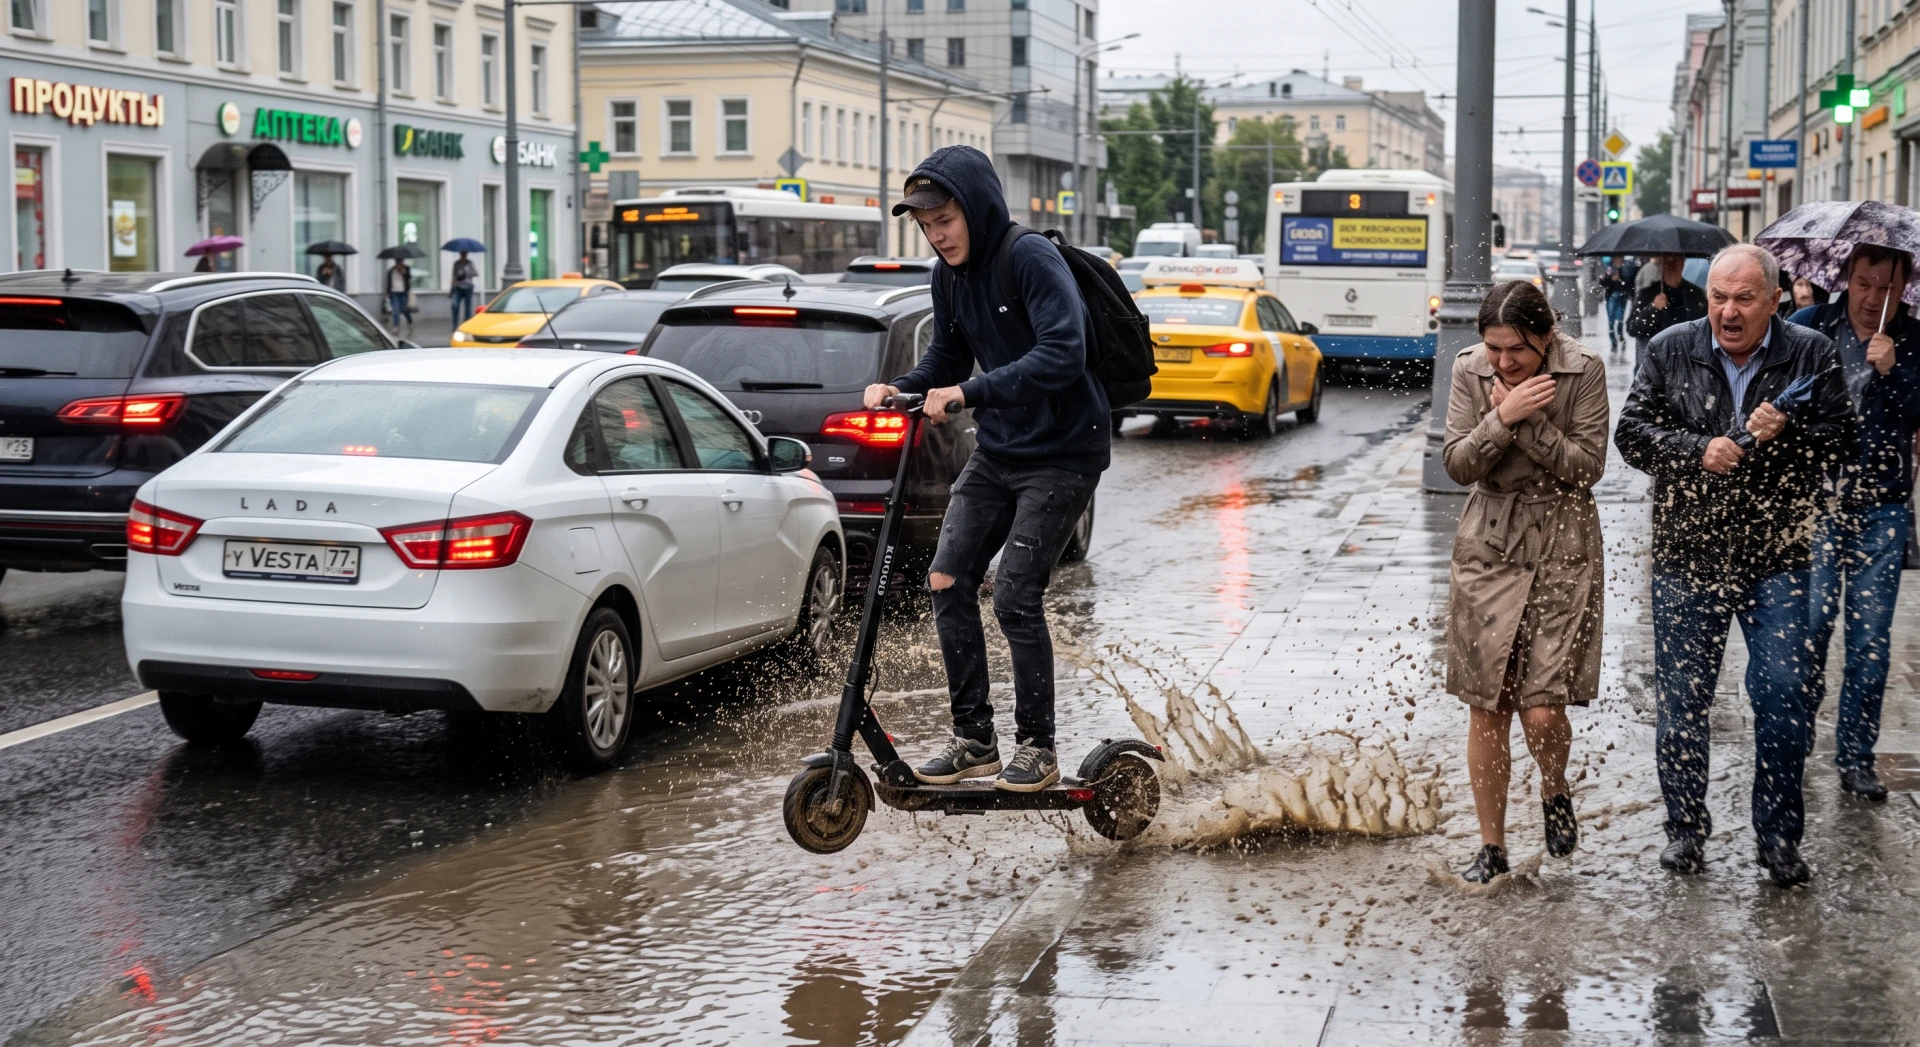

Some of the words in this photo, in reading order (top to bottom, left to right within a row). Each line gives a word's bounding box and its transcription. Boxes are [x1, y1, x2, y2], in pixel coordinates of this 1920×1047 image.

[11, 77, 165, 126] ПРОДУКТЫ
[254, 107, 344, 145] АПТЕКА
[414, 128, 465, 159] БАНК
[517, 140, 558, 168] БАНК
[240, 497, 338, 514] LADA
[328, 549, 350, 567] 77
